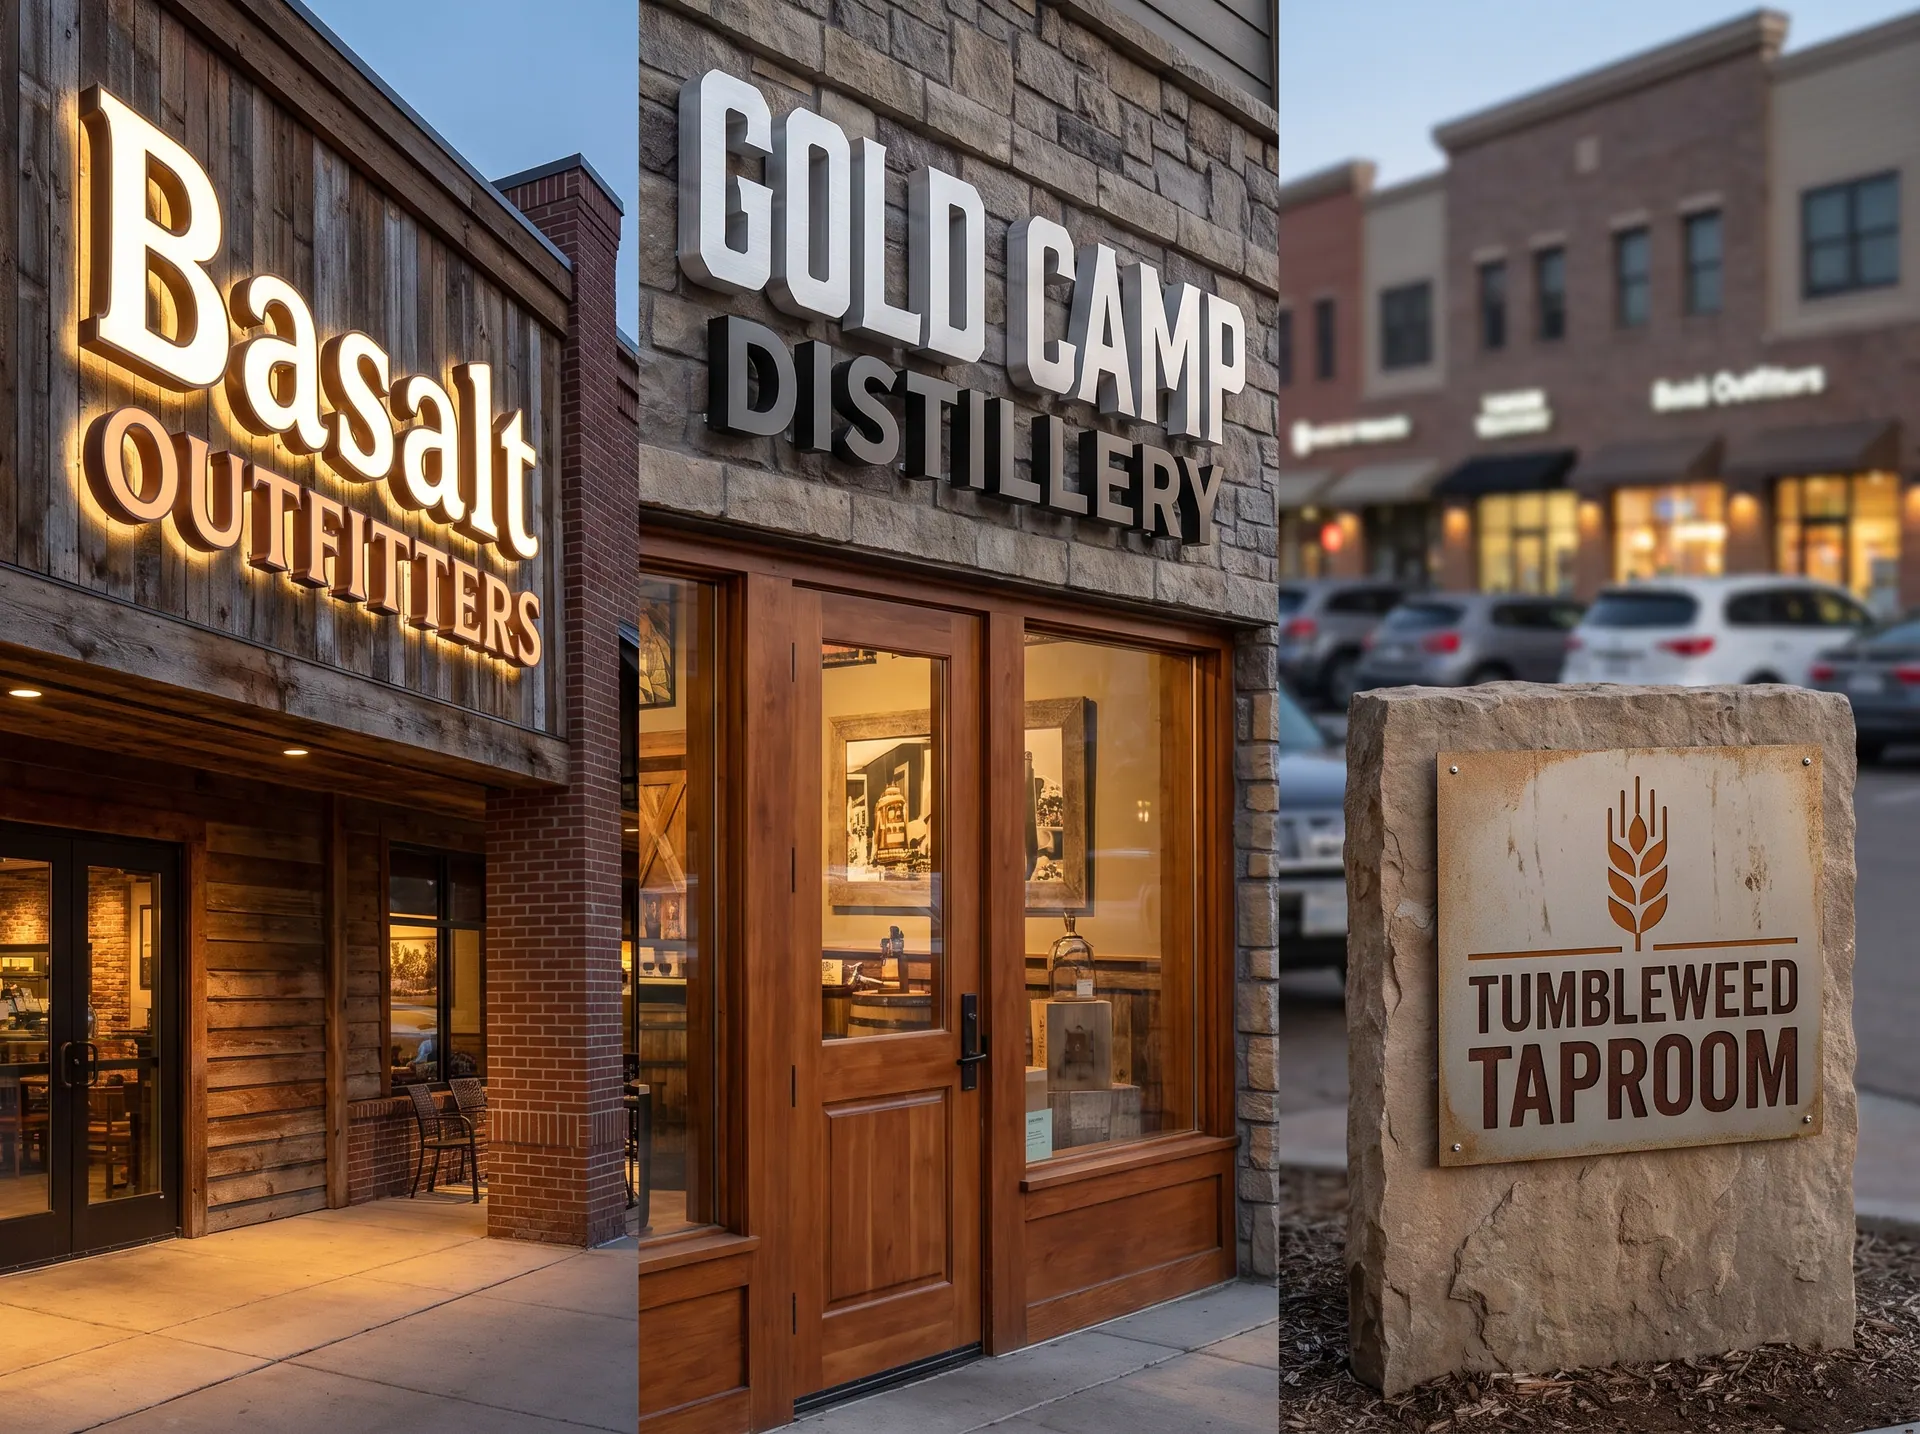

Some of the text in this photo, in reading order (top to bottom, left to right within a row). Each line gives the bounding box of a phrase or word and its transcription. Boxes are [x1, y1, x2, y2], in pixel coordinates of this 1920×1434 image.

[79, 81, 540, 561] Basalt
[678, 68, 1246, 446] GOLD CAMP
[83, 405, 542, 668] OUTFITTERS
[707, 314, 1224, 546] DISTILLERY
[1468, 1026, 1798, 1130] TAPROOM
[1469, 959, 1798, 1034] TUMBLEWEED
